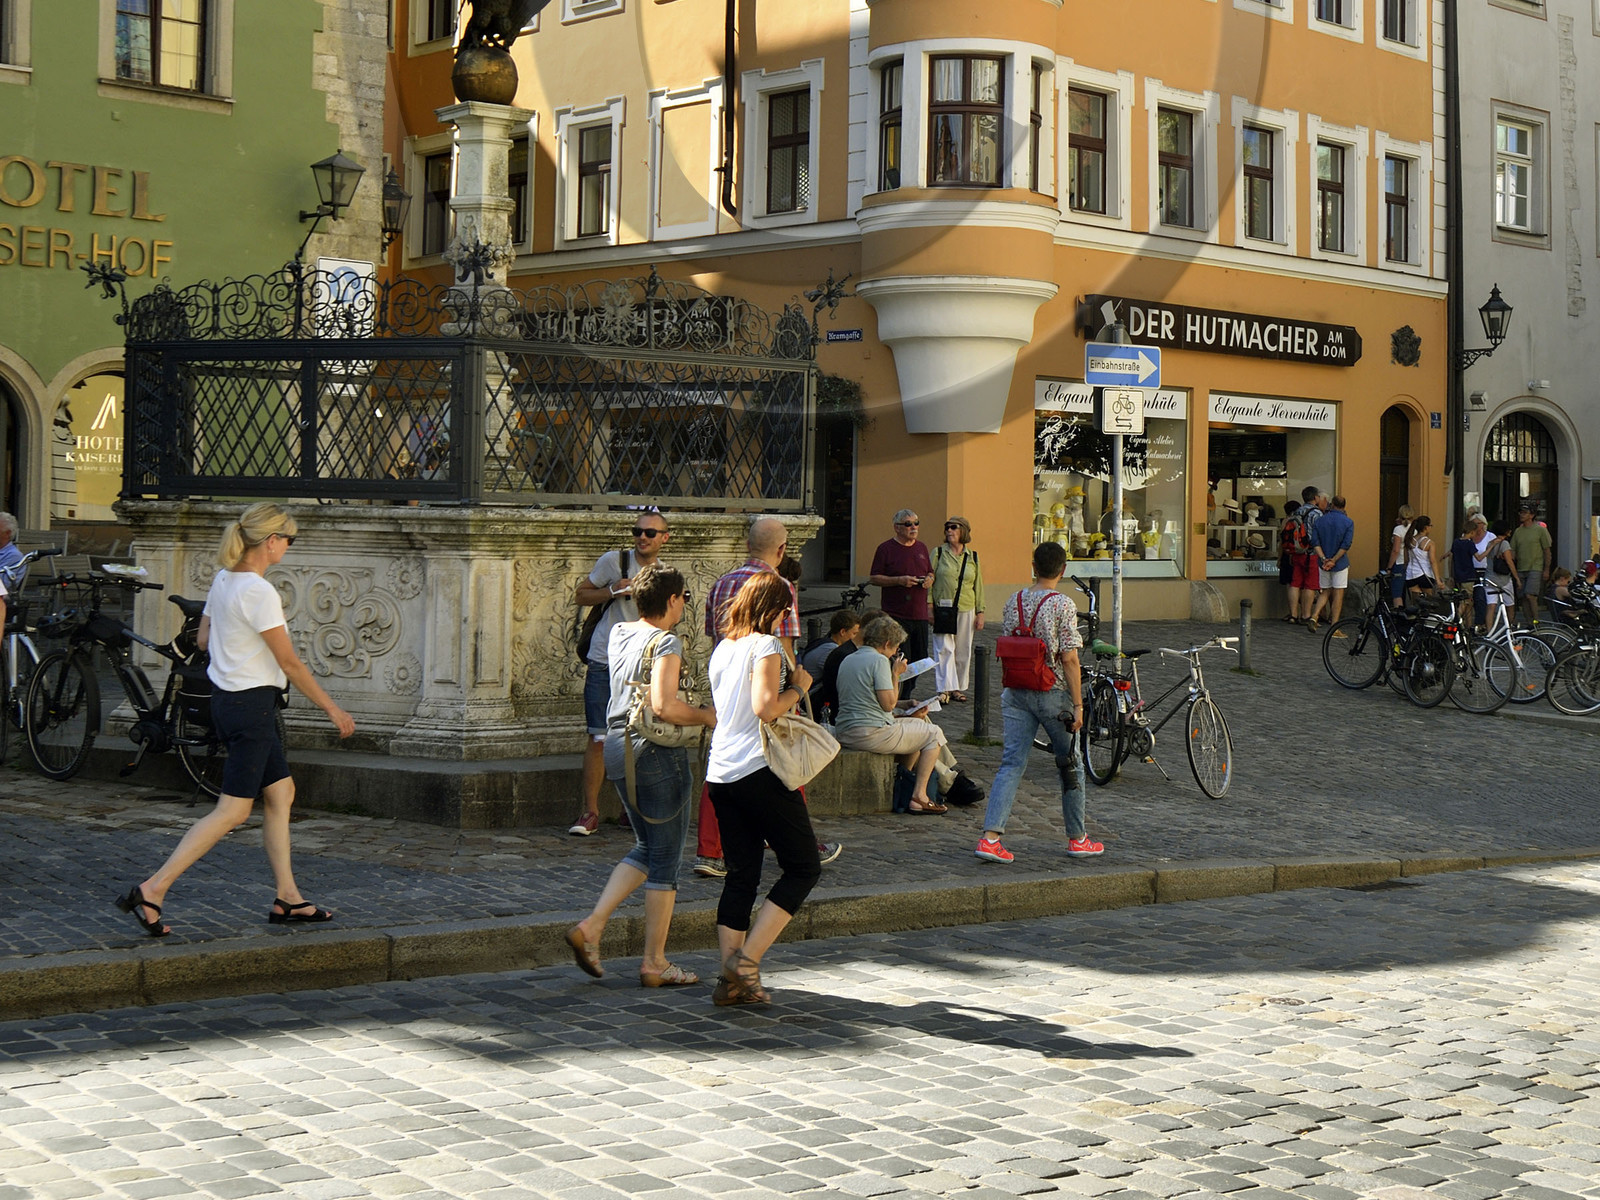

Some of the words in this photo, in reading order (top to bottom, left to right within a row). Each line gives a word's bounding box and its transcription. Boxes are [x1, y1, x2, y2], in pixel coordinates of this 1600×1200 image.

[1129, 306, 1175, 340] DER
[1185, 313, 1319, 356] HUTMACHER
[1327, 330, 1343, 345] AM
[1323, 344, 1347, 359] DOM
[1090, 359, 1141, 372] Einbahnstraße
[1214, 396, 1264, 422] Elegante
[1267, 401, 1329, 422] Herrenhüte
